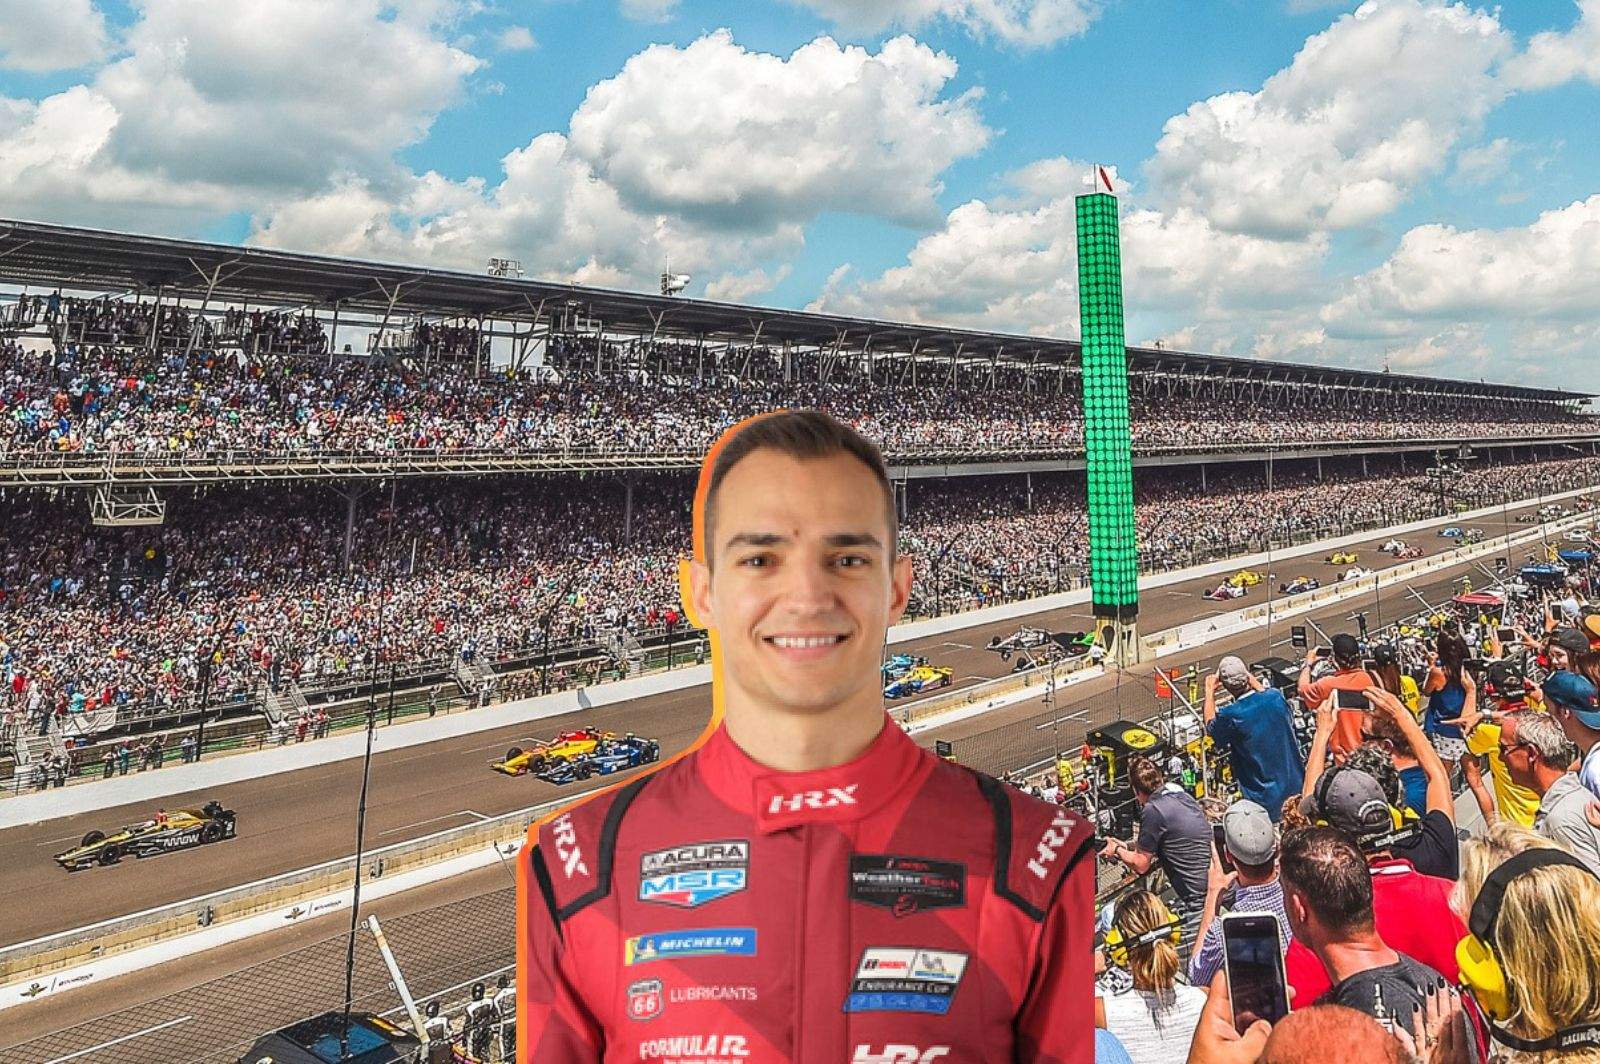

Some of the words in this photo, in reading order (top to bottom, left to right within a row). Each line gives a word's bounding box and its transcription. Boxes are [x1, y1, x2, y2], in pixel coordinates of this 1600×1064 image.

[768, 783, 859, 814] HRX
[164, 834, 200, 847] ARROW
[553, 812, 590, 879] HRX
[1027, 810, 1077, 879] HRX
[663, 844, 743, 864] ACURA
[642, 871, 745, 895] MSR
[852, 872, 960, 889] WeatherTech
[659, 936, 745, 950] MICHELIN
[669, 986, 758, 1003] LUBRICANTS
[633, 996, 657, 1015] 66
[640, 1034, 719, 1061] FORMULA
